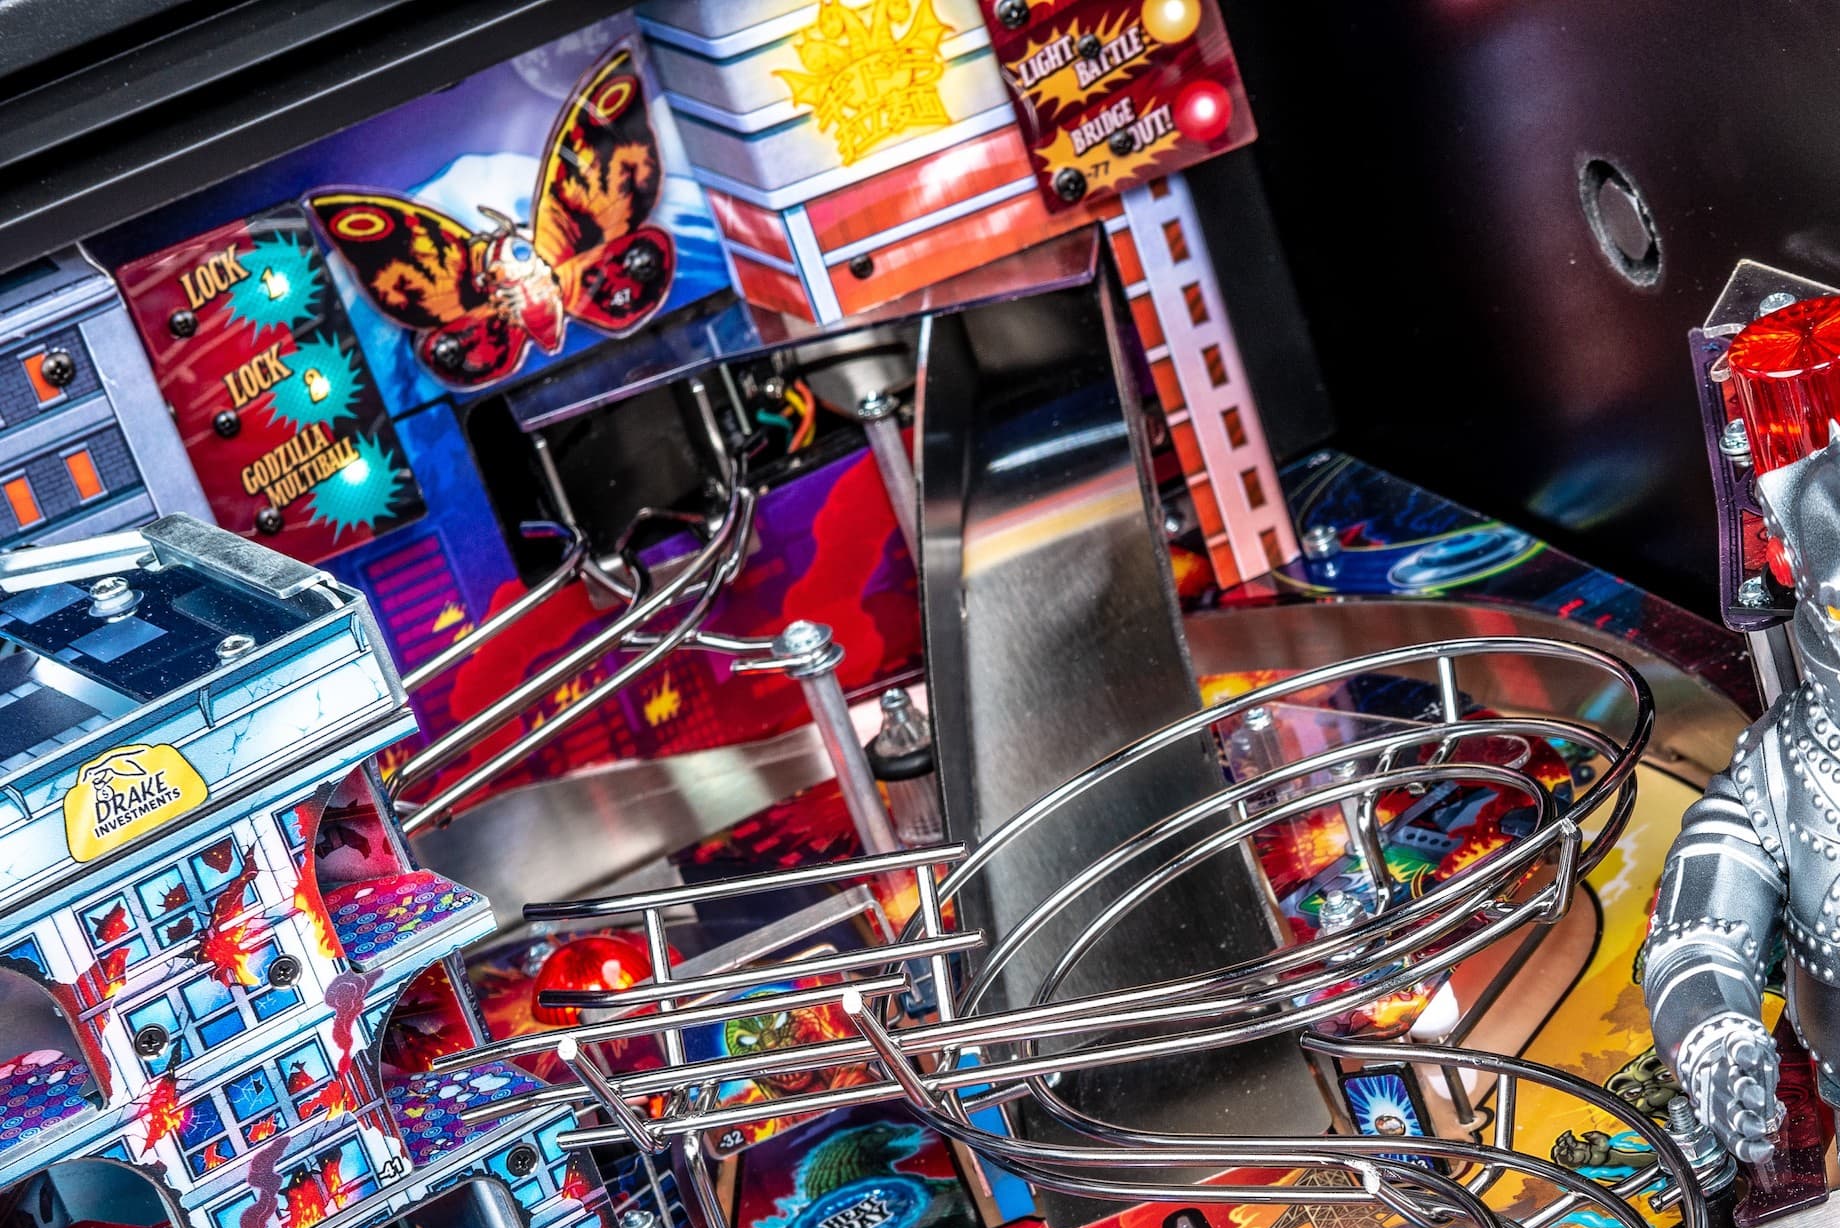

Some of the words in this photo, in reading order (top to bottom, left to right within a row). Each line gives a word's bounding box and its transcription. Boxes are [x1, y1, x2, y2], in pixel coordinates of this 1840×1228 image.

[1017, 35, 1076, 89] LIGHT
[1075, 26, 1144, 89] BATTLE
[1070, 97, 1136, 156] BRIDGE
[180, 245, 249, 310] LOCK
[262, 267, 285, 299] 1
[224, 342, 293, 408] LOCK
[241, 423, 332, 496] GODZILLA
[265, 436, 360, 509] MULTIBALL
[94, 788, 181, 838] INVESTMENTS
[95, 771, 168, 824] DRAKE
[378, 1157, 405, 1181] -41
[719, 1130, 744, 1149] -32
